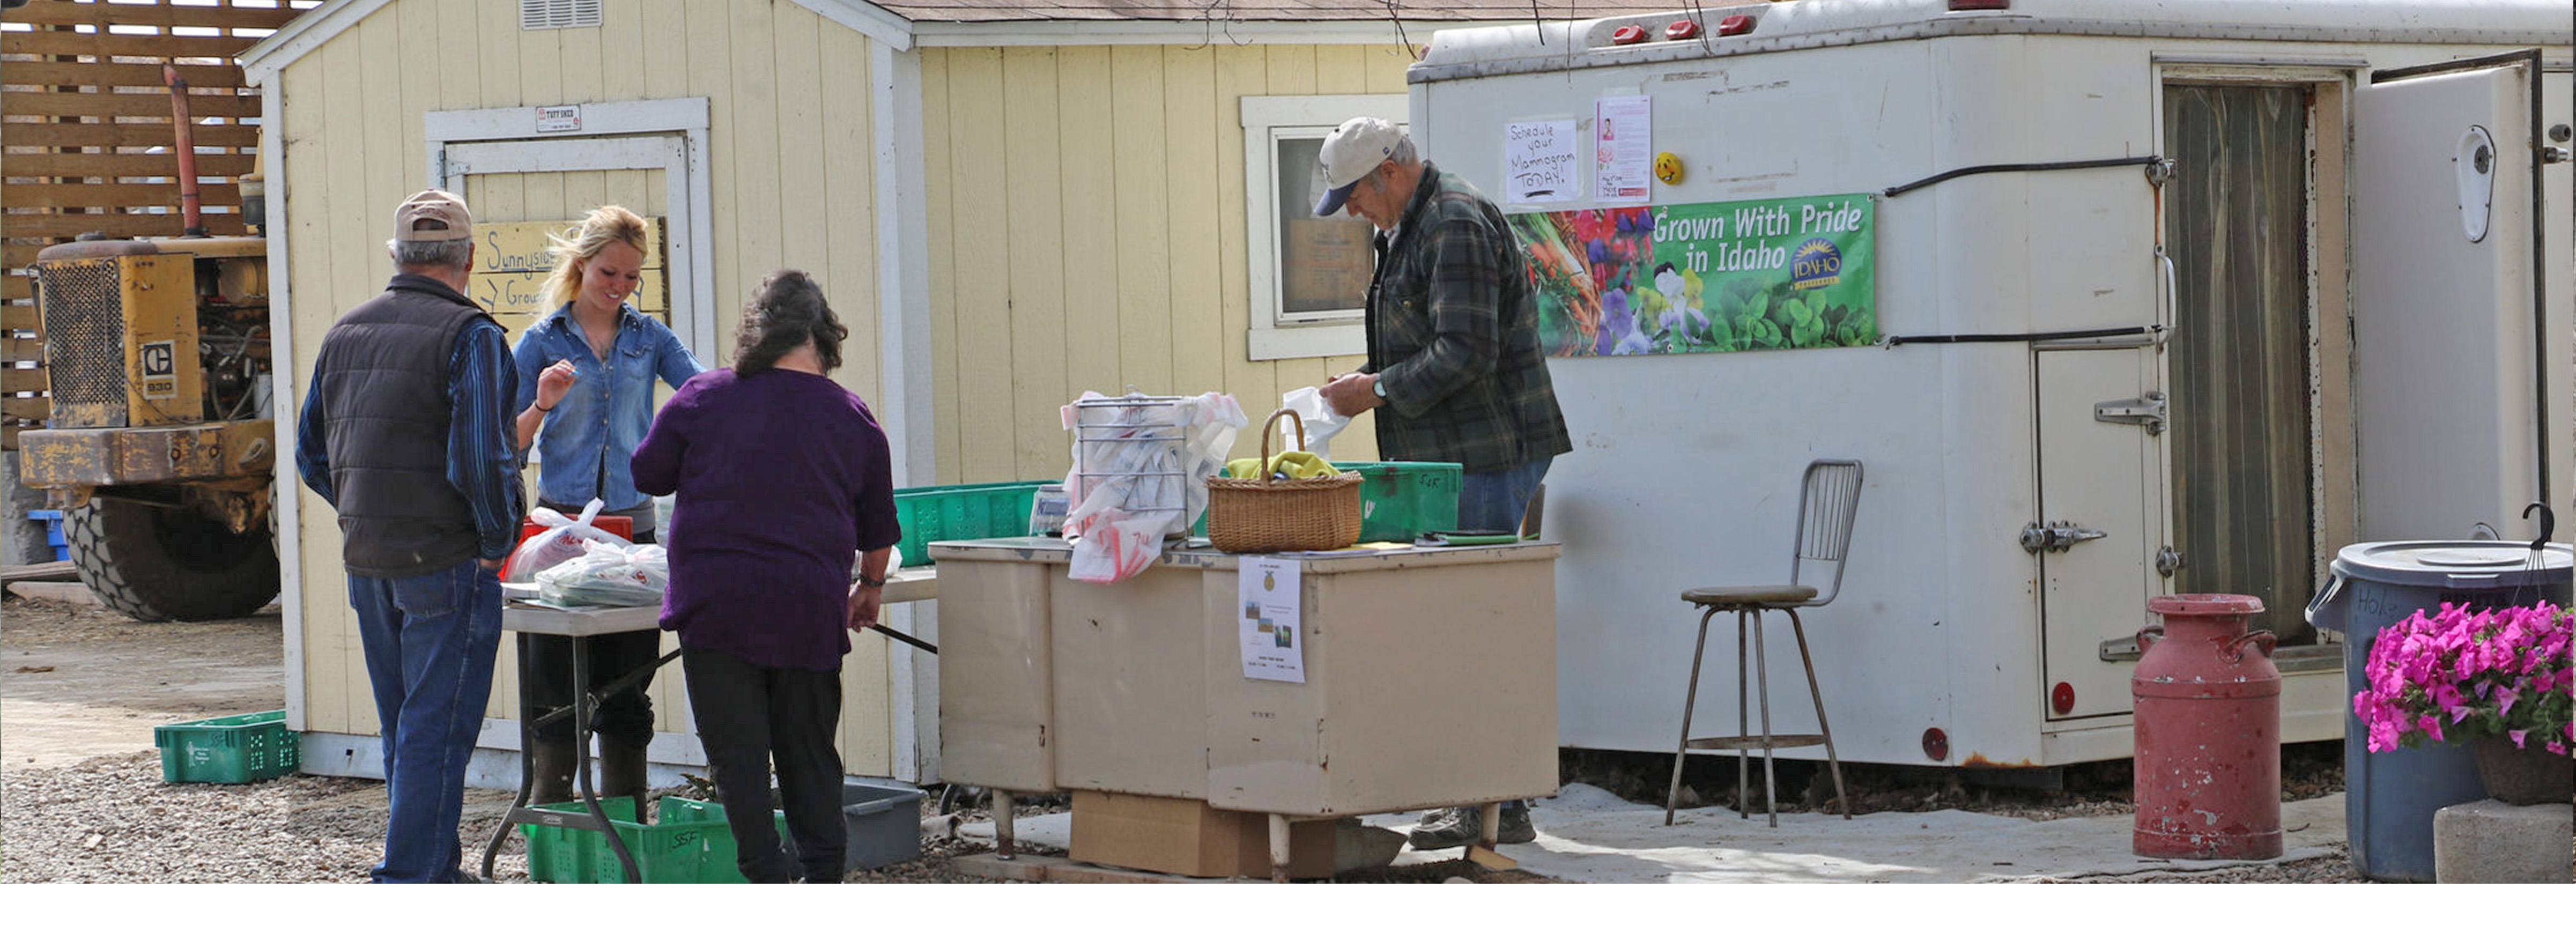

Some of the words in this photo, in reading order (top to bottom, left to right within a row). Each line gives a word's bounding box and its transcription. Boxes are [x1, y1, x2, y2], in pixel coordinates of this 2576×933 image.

[1511, 123, 1553, 140] Schedule
[1528, 138, 1553, 158] your
[1511, 153, 1575, 172] Mammogram
[1515, 164, 1565, 187] TODAY!
[1653, 212, 1724, 242] Grown
[1735, 205, 1790, 238] With
[1801, 201, 1862, 234] Pride
[1686, 243, 1709, 272] in
[1717, 240, 1786, 272] Idaho
[1794, 257, 1840, 279] IDAHO
[147, 382, 172, 392] 930
